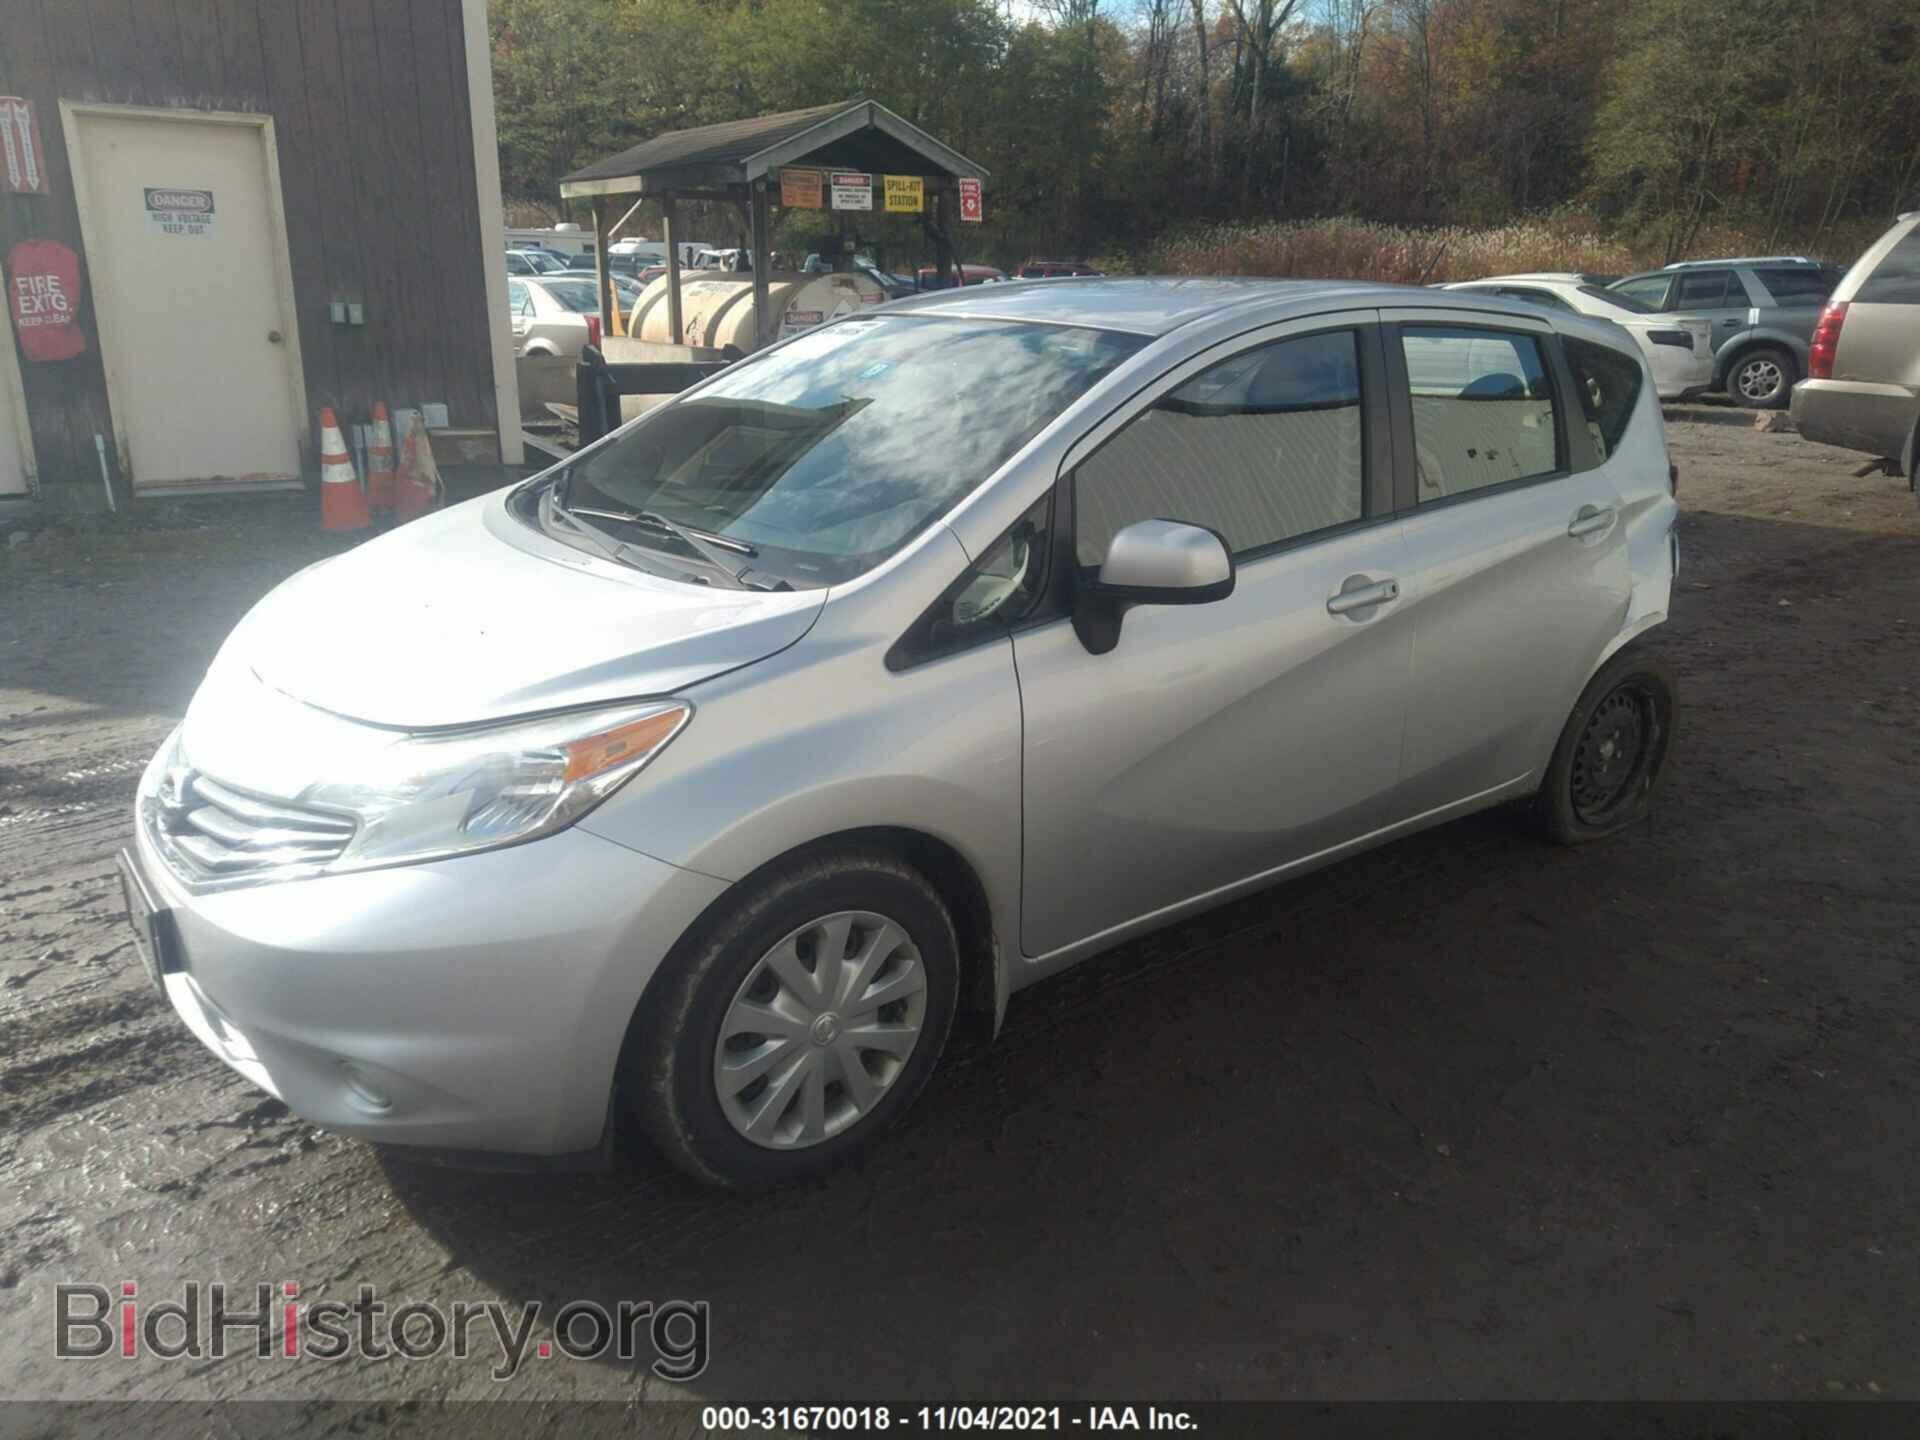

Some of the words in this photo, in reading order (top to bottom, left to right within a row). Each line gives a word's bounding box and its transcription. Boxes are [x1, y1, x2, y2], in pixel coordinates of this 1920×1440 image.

[154, 193, 206, 208] DANGER
[889, 194, 918, 207] STATION
[152, 213, 174, 223] HIGH
[177, 214, 212, 225] VOLTAGE
[162, 223, 185, 233] KEEP
[187, 224, 206, 235] OUT
[15, 274, 61, 295] FIRE
[18, 316, 42, 327] KEEP
